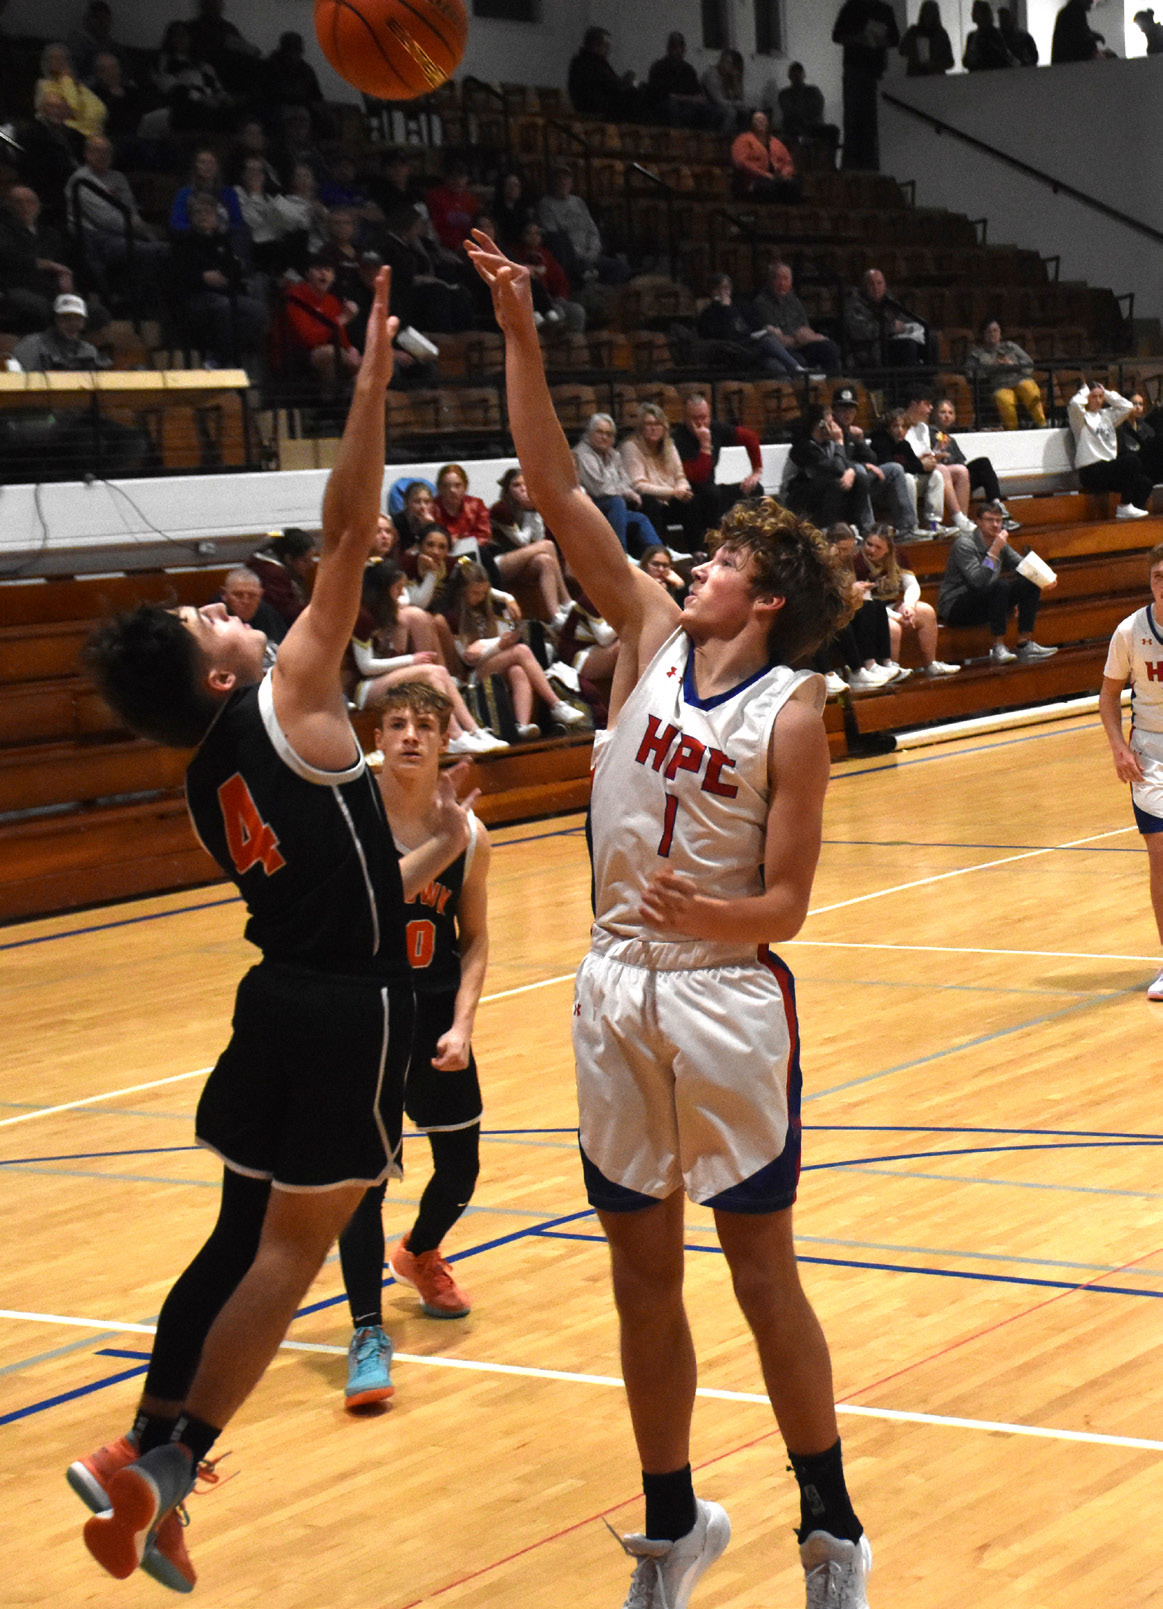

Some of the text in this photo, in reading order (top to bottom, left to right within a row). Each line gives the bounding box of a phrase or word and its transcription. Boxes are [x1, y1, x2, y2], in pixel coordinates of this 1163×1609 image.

[635, 713, 739, 799] HPC
[217, 771, 287, 877] 4
[657, 791, 679, 858] 1
[405, 919, 437, 969] 0
